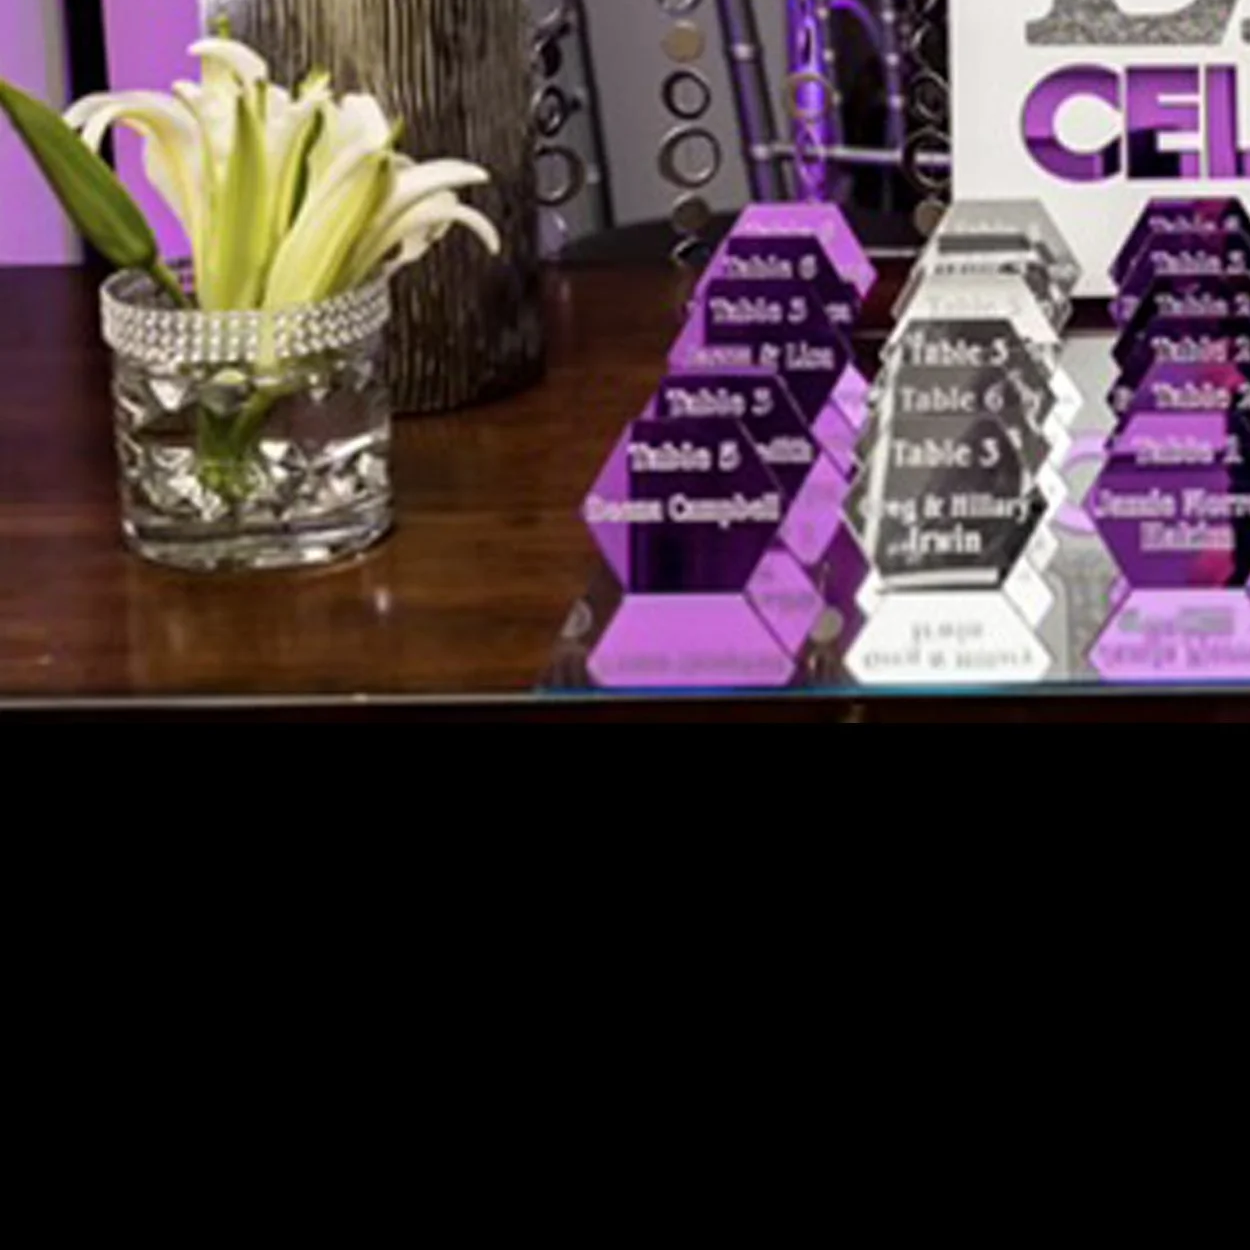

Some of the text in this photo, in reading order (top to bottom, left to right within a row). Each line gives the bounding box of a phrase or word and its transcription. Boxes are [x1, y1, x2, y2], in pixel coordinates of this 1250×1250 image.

[709, 297, 783, 324] Table
[665, 388, 745, 418] Table
[902, 385, 977, 414] Table
[983, 382, 1005, 413] 6
[1152, 382, 1231, 410] Table
[626, 440, 712, 471] Table
[893, 436, 972, 468] Table
[923, 495, 945, 518] &
